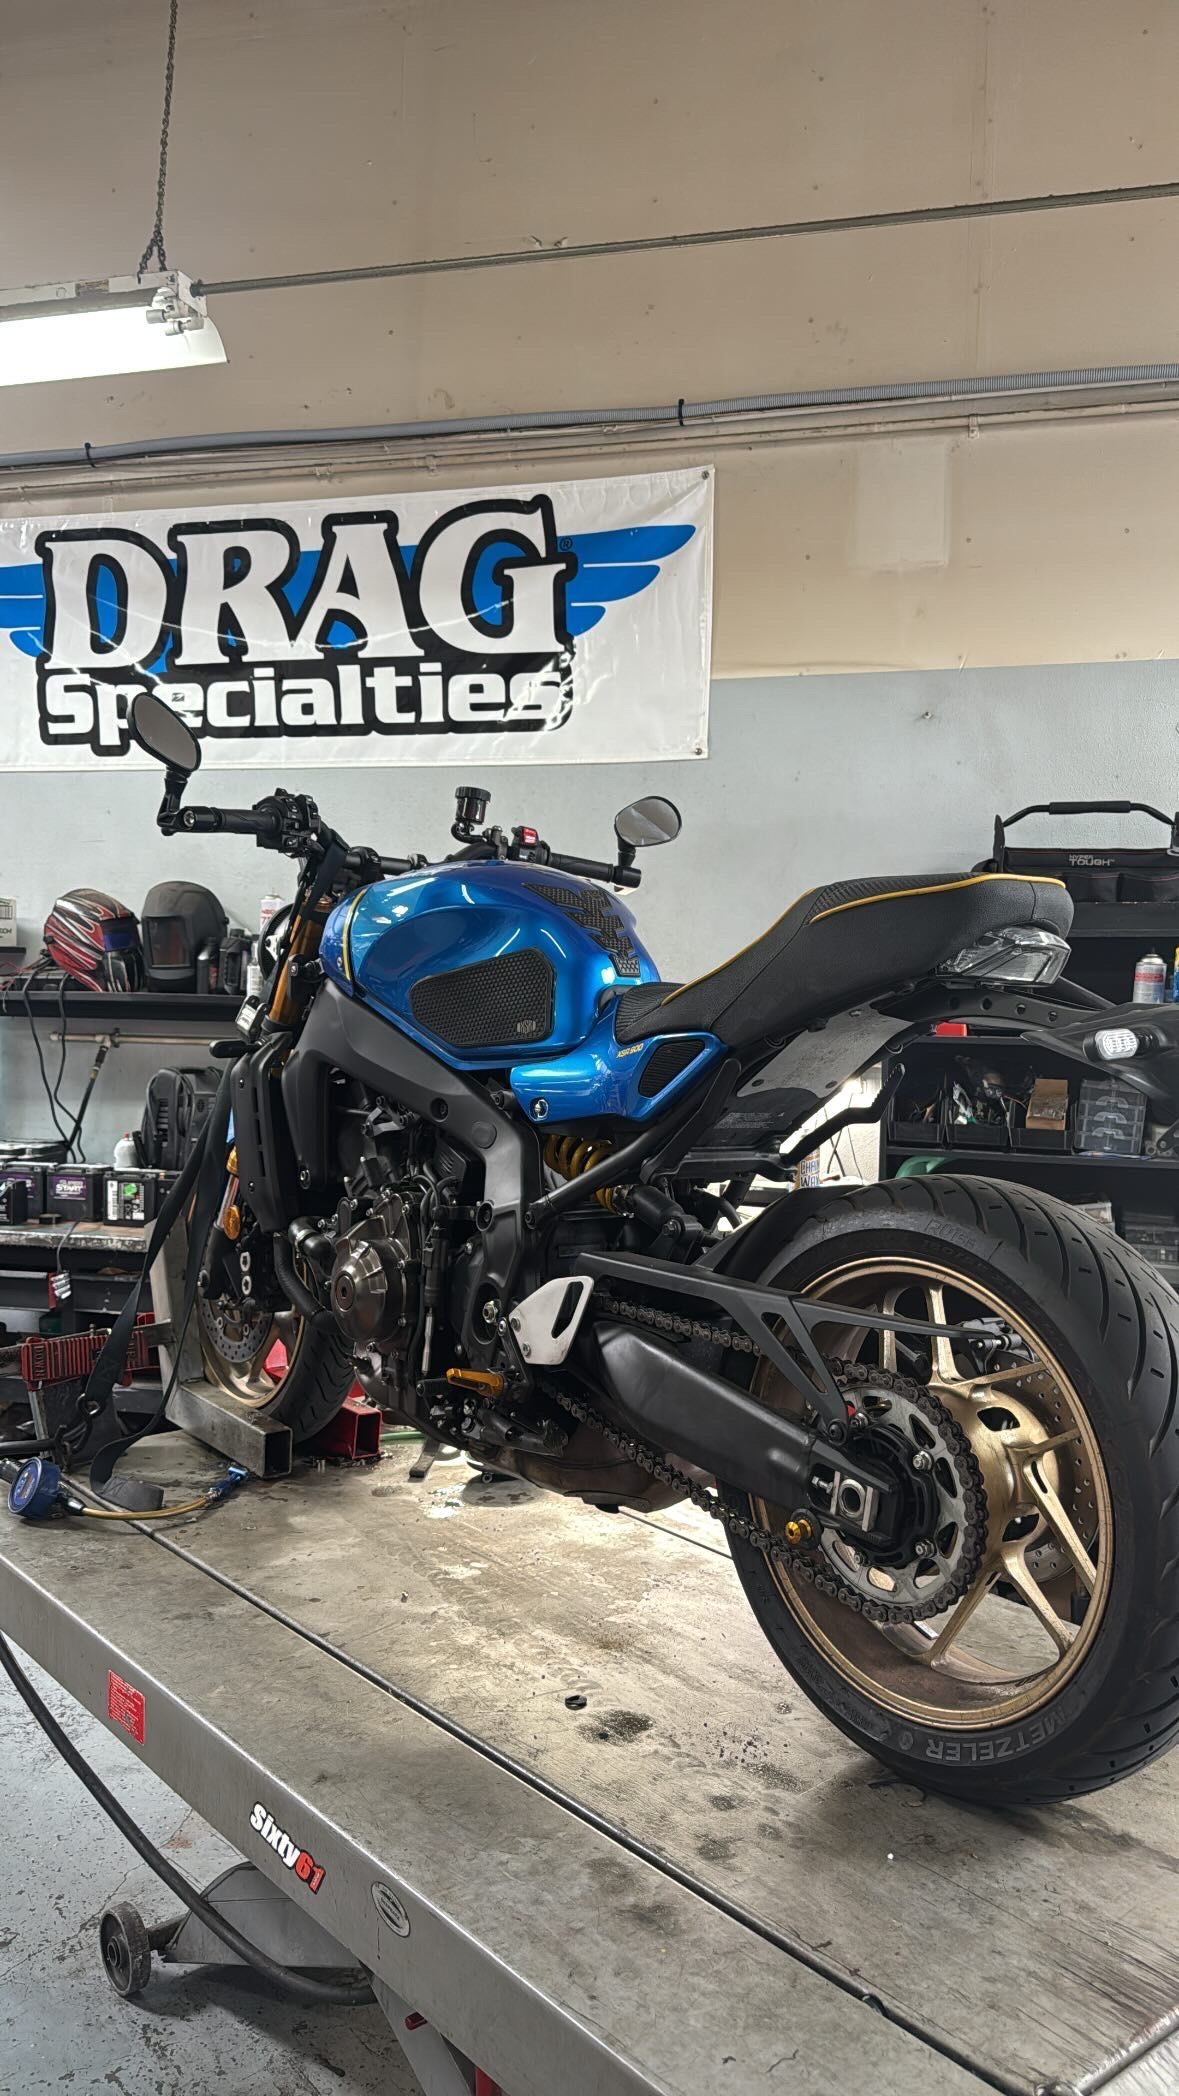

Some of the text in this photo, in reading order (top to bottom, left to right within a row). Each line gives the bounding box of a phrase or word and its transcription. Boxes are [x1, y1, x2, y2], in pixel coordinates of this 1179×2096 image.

[38, 496, 574, 670] DRAG
[44, 661, 566, 748] Specialties
[1069, 857, 1110, 866] TOUGH
[925, 1705, 1067, 1761] METZELER
[249, 1802, 325, 1894] Sixty61
